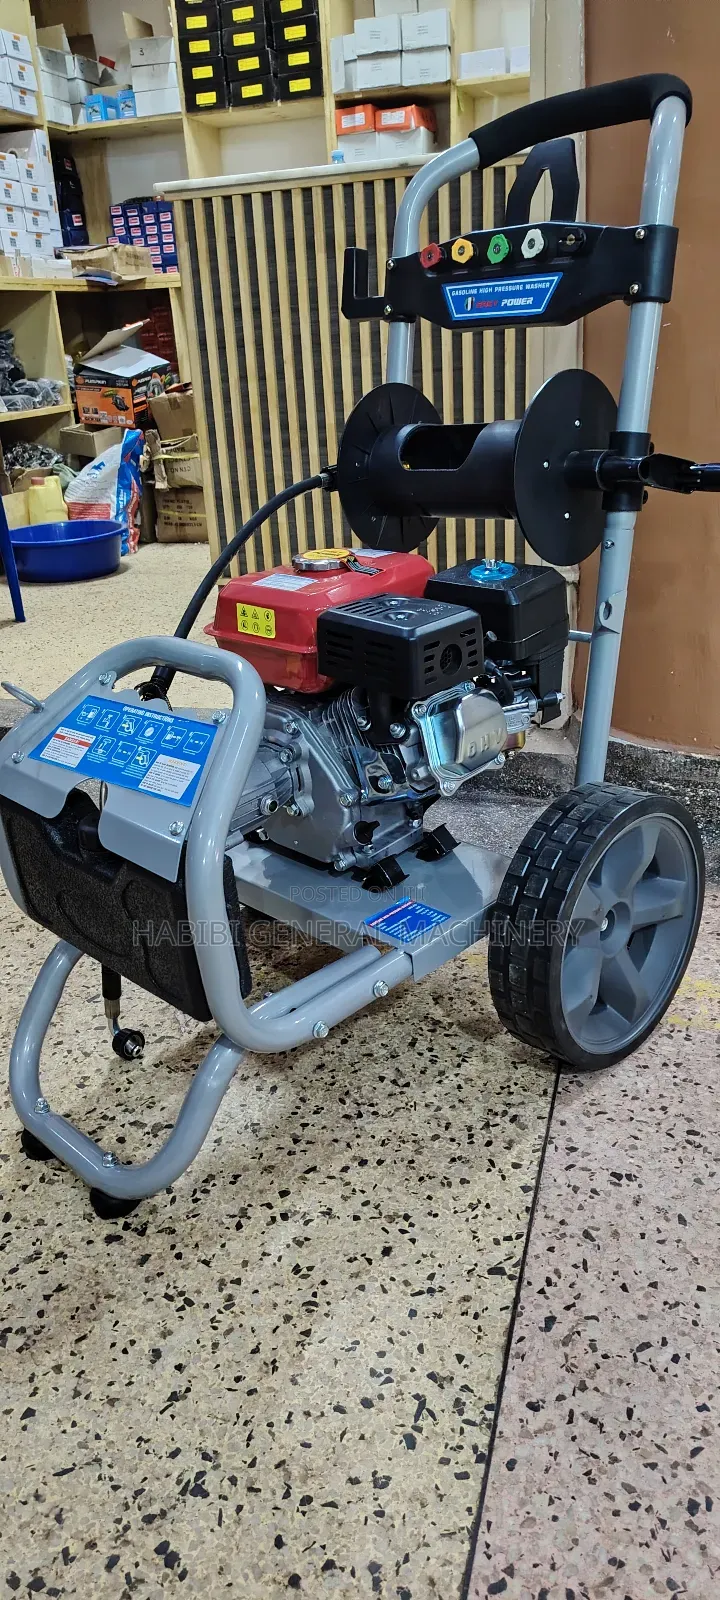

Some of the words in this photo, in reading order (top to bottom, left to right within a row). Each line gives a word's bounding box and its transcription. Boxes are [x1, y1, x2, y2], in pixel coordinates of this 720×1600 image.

[479, 286, 493, 294] HIGH
[494, 284, 524, 293] PRESSURE
[525, 282, 551, 290] WASHER
[501, 296, 534, 307] POWER
